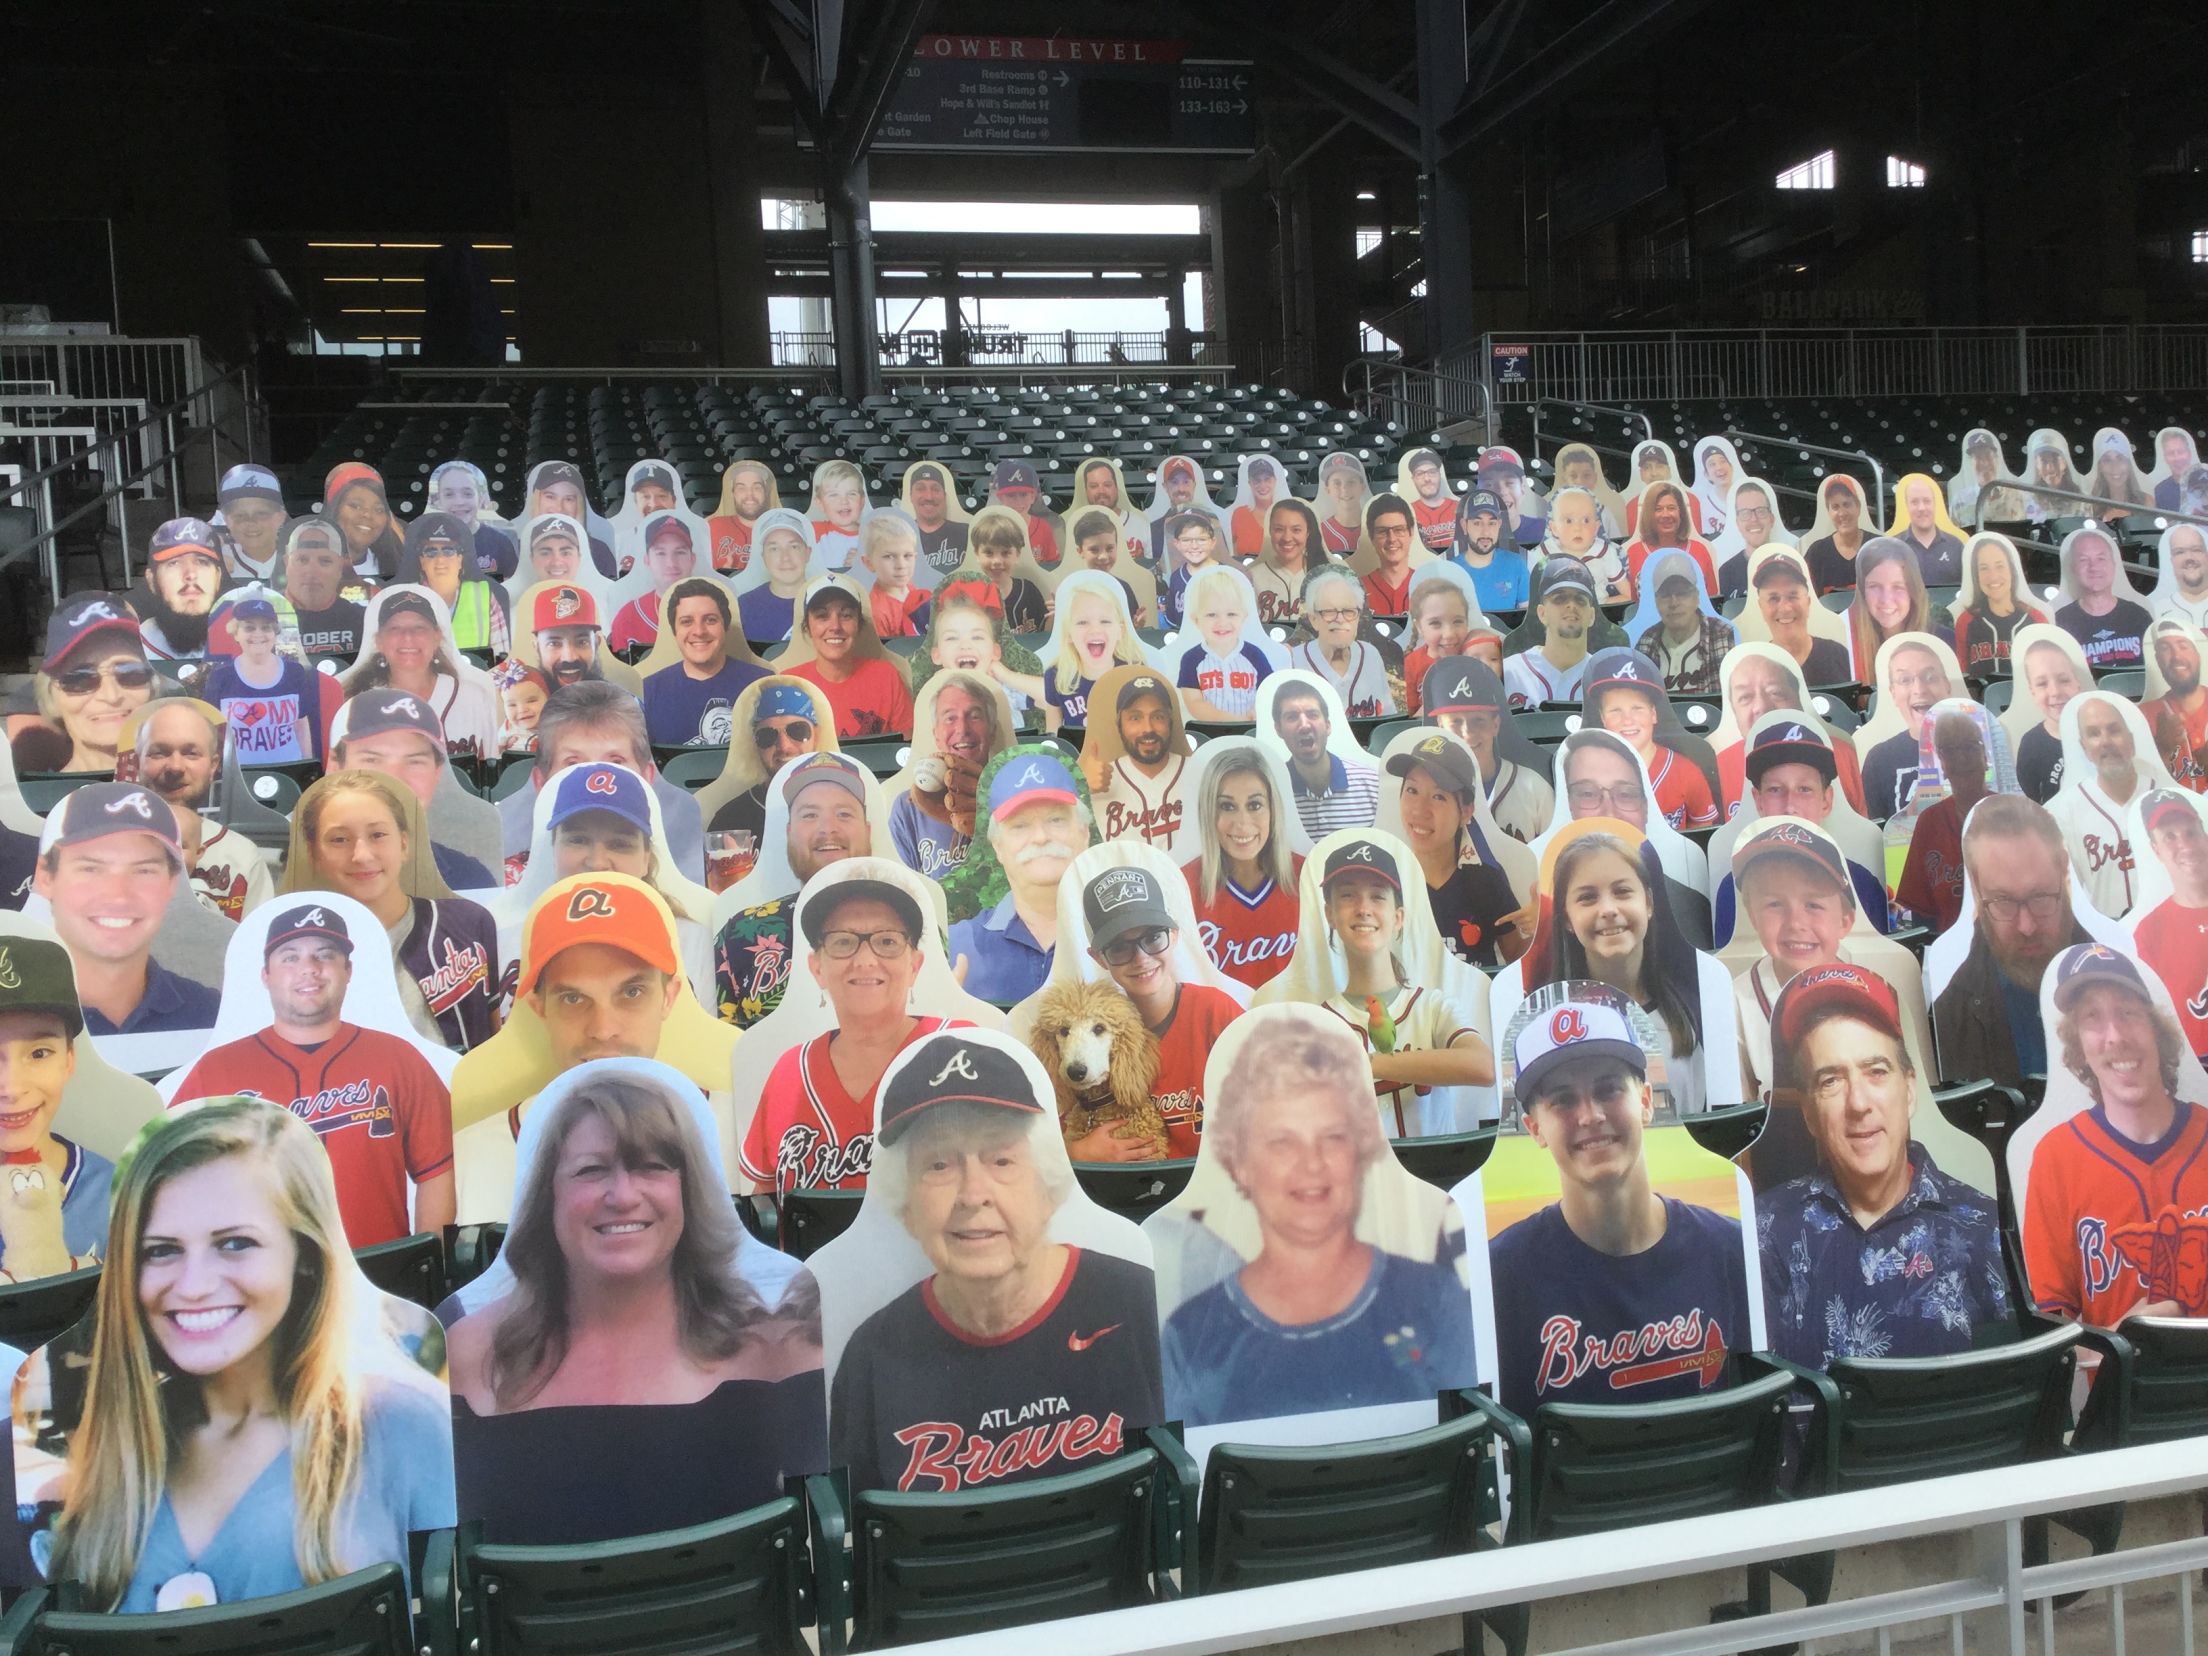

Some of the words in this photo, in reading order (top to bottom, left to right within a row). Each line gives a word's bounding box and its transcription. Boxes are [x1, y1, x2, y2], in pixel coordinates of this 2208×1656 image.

[1046, 39, 1147, 62] LEVEL
[981, 69, 1036, 81] Restrooms
[959, 83, 976, 94] 3rd
[979, 84, 1004, 95] Base
[1007, 85, 1036, 97] Ramp
[894, 112, 932, 123] Garden
[989, 114, 1015, 126] Chop
[1018, 114, 1049, 125] House
[887, 126, 912, 137] Gate
[963, 128, 983, 139] Left
[986, 129, 1010, 140] Field
[1012, 130, 1037, 140] Gate
[1494, 346, 1529, 356] CAUTION
[645, 463, 658, 478] T
[1007, 468, 1023, 482] A
[1938, 551, 1950, 562] A
[1611, 660, 1638, 681] A
[1448, 676, 1473, 699] A
[267, 700, 298, 725] MY
[1781, 723, 1804, 743] A
[1013, 762, 1045, 788] A
[1346, 844, 1373, 862] A
[1096, 871, 1143, 895] PENNANT
[294, 907, 326, 928] A
[929, 1049, 979, 1087] A
[1535, 1307, 1704, 1397] Braves
[978, 1396, 1071, 1431] ATLANTA
[893, 1411, 1125, 1493] Braves
